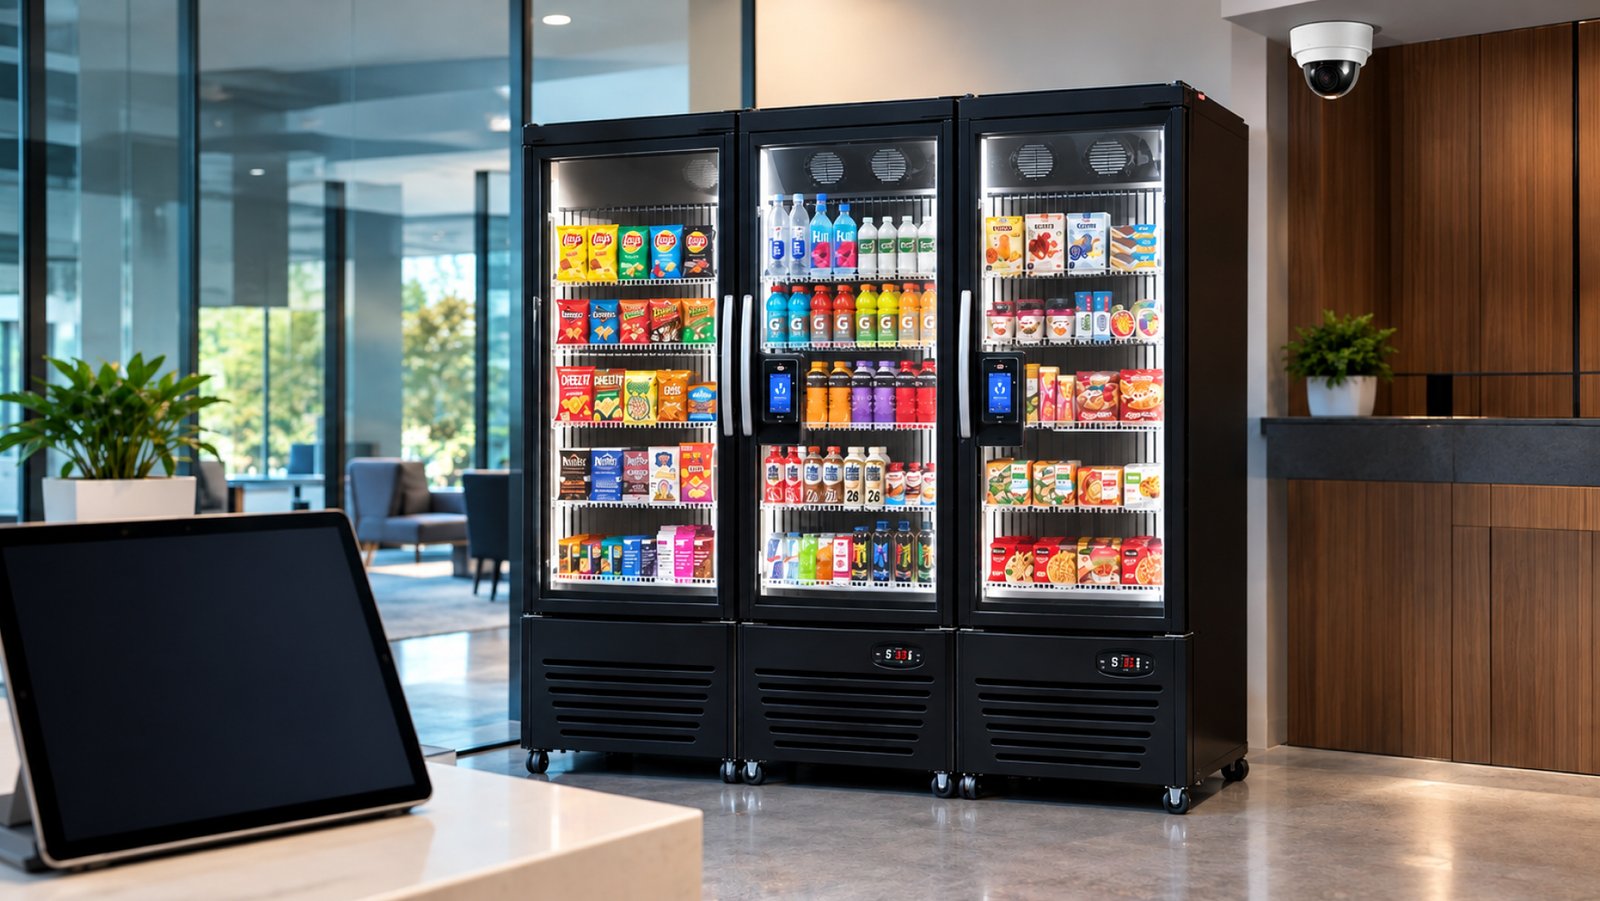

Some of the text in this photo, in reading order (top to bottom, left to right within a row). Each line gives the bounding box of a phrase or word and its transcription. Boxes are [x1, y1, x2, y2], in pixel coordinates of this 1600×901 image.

[769, 318, 780, 331] G
[791, 318, 802, 331] G
[814, 317, 825, 330] G
[837, 317, 848, 330] G
[859, 317, 870, 330] G
[881, 317, 892, 330] G
[902, 316, 913, 329] G
[847, 490, 859, 502] 26
[868, 490, 881, 502] 26
